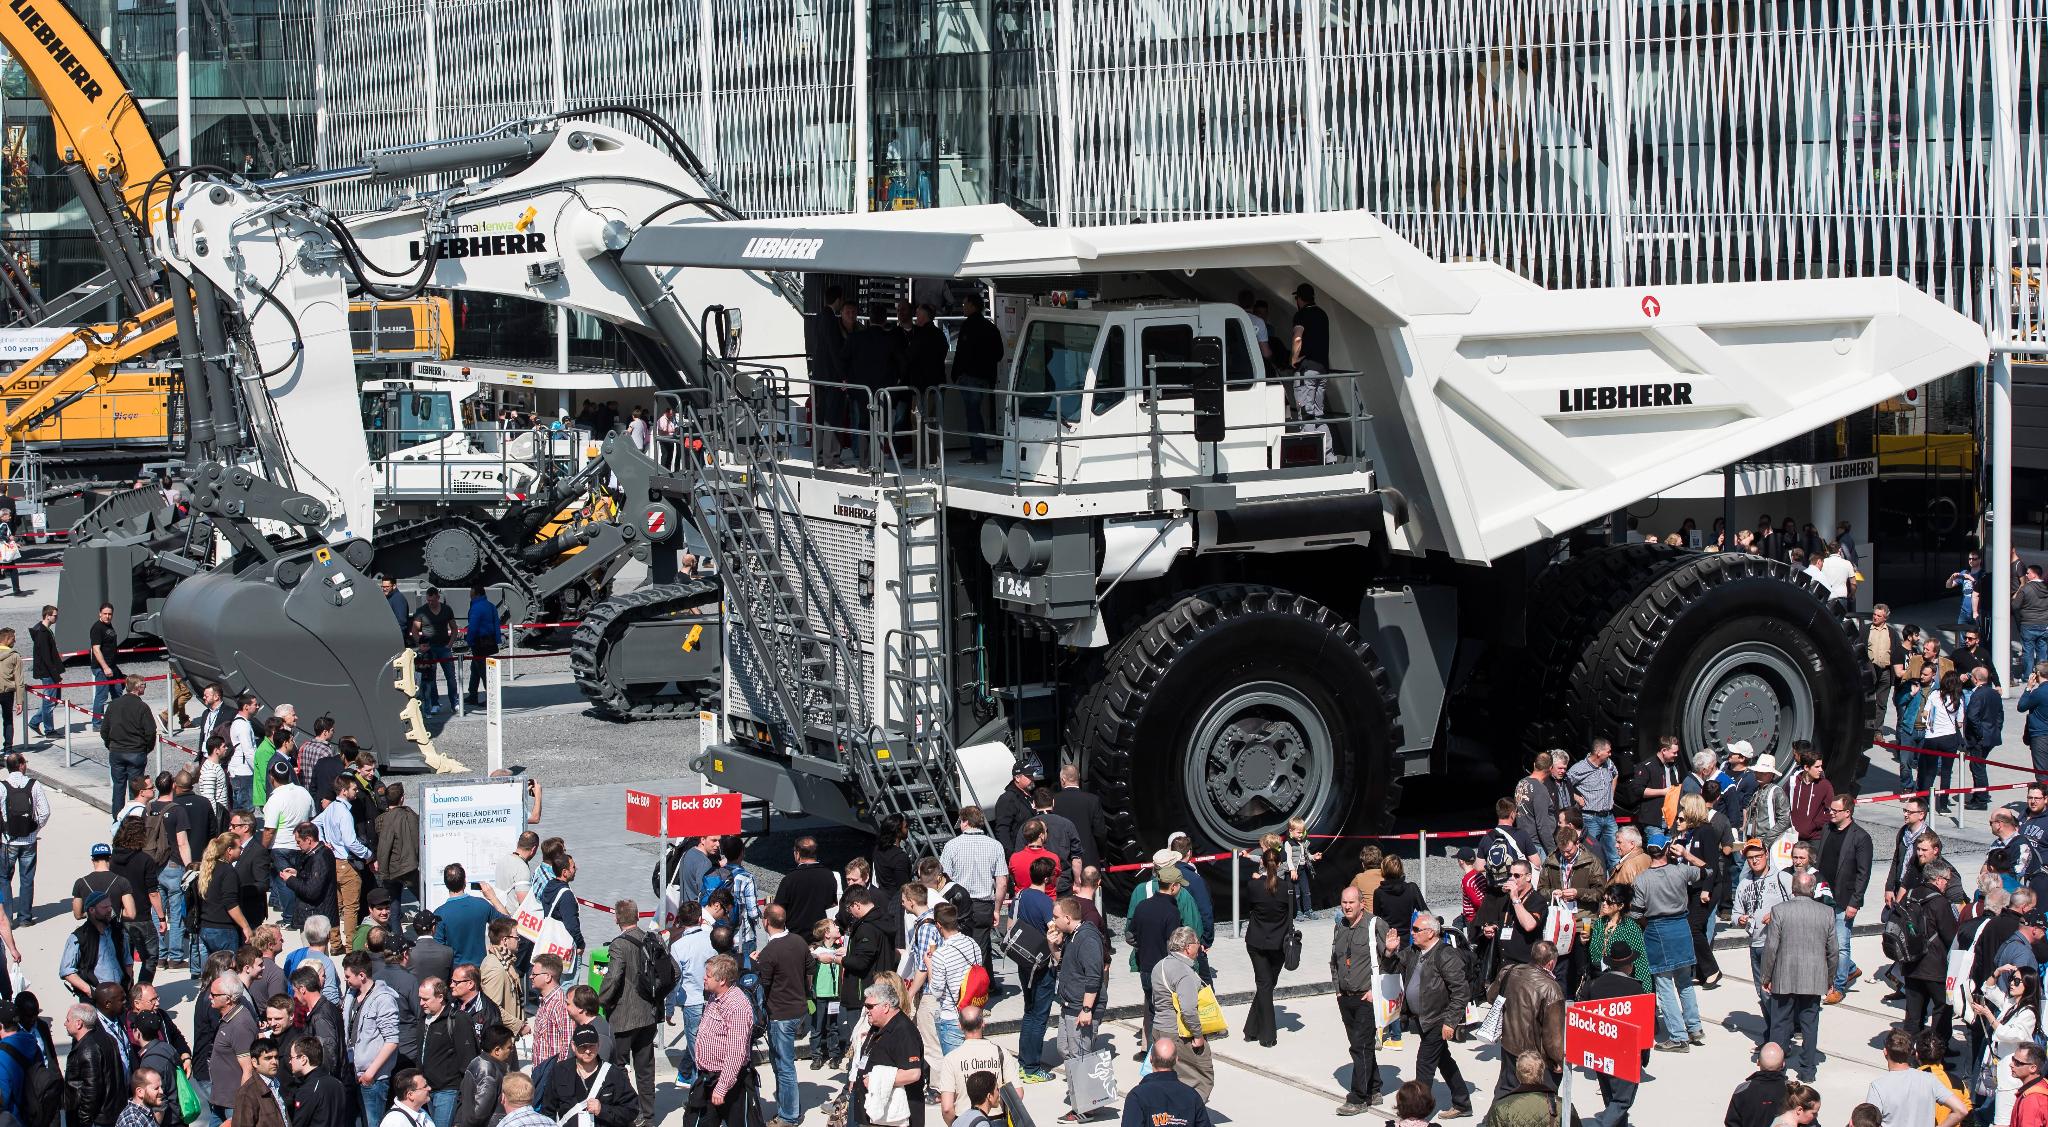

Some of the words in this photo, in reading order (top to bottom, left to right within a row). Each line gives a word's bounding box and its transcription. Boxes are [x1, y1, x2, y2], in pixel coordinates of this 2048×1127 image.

[9, 0, 103, 104] LIEBHERR
[409, 232, 547, 261] LEBHERR
[741, 237, 824, 260] LIEBHERR
[1559, 382, 1693, 412] LIEBHERR
[460, 470, 493, 480] 776
[1829, 461, 1874, 480] LIEBHERR
[833, 504, 869, 520] LIEBHERR
[1007, 577, 1031, 598] 264
[432, 793, 459, 803] bauma
[671, 798, 700, 811] Block
[702, 797, 722, 809] 809
[517, 910, 543, 932] PERI
[1608, 1001, 1632, 1017] 808
[1568, 1012, 1597, 1033] Block
[1598, 1021, 1618, 1039] 808
[971, 1057, 1001, 1070] Charolai
